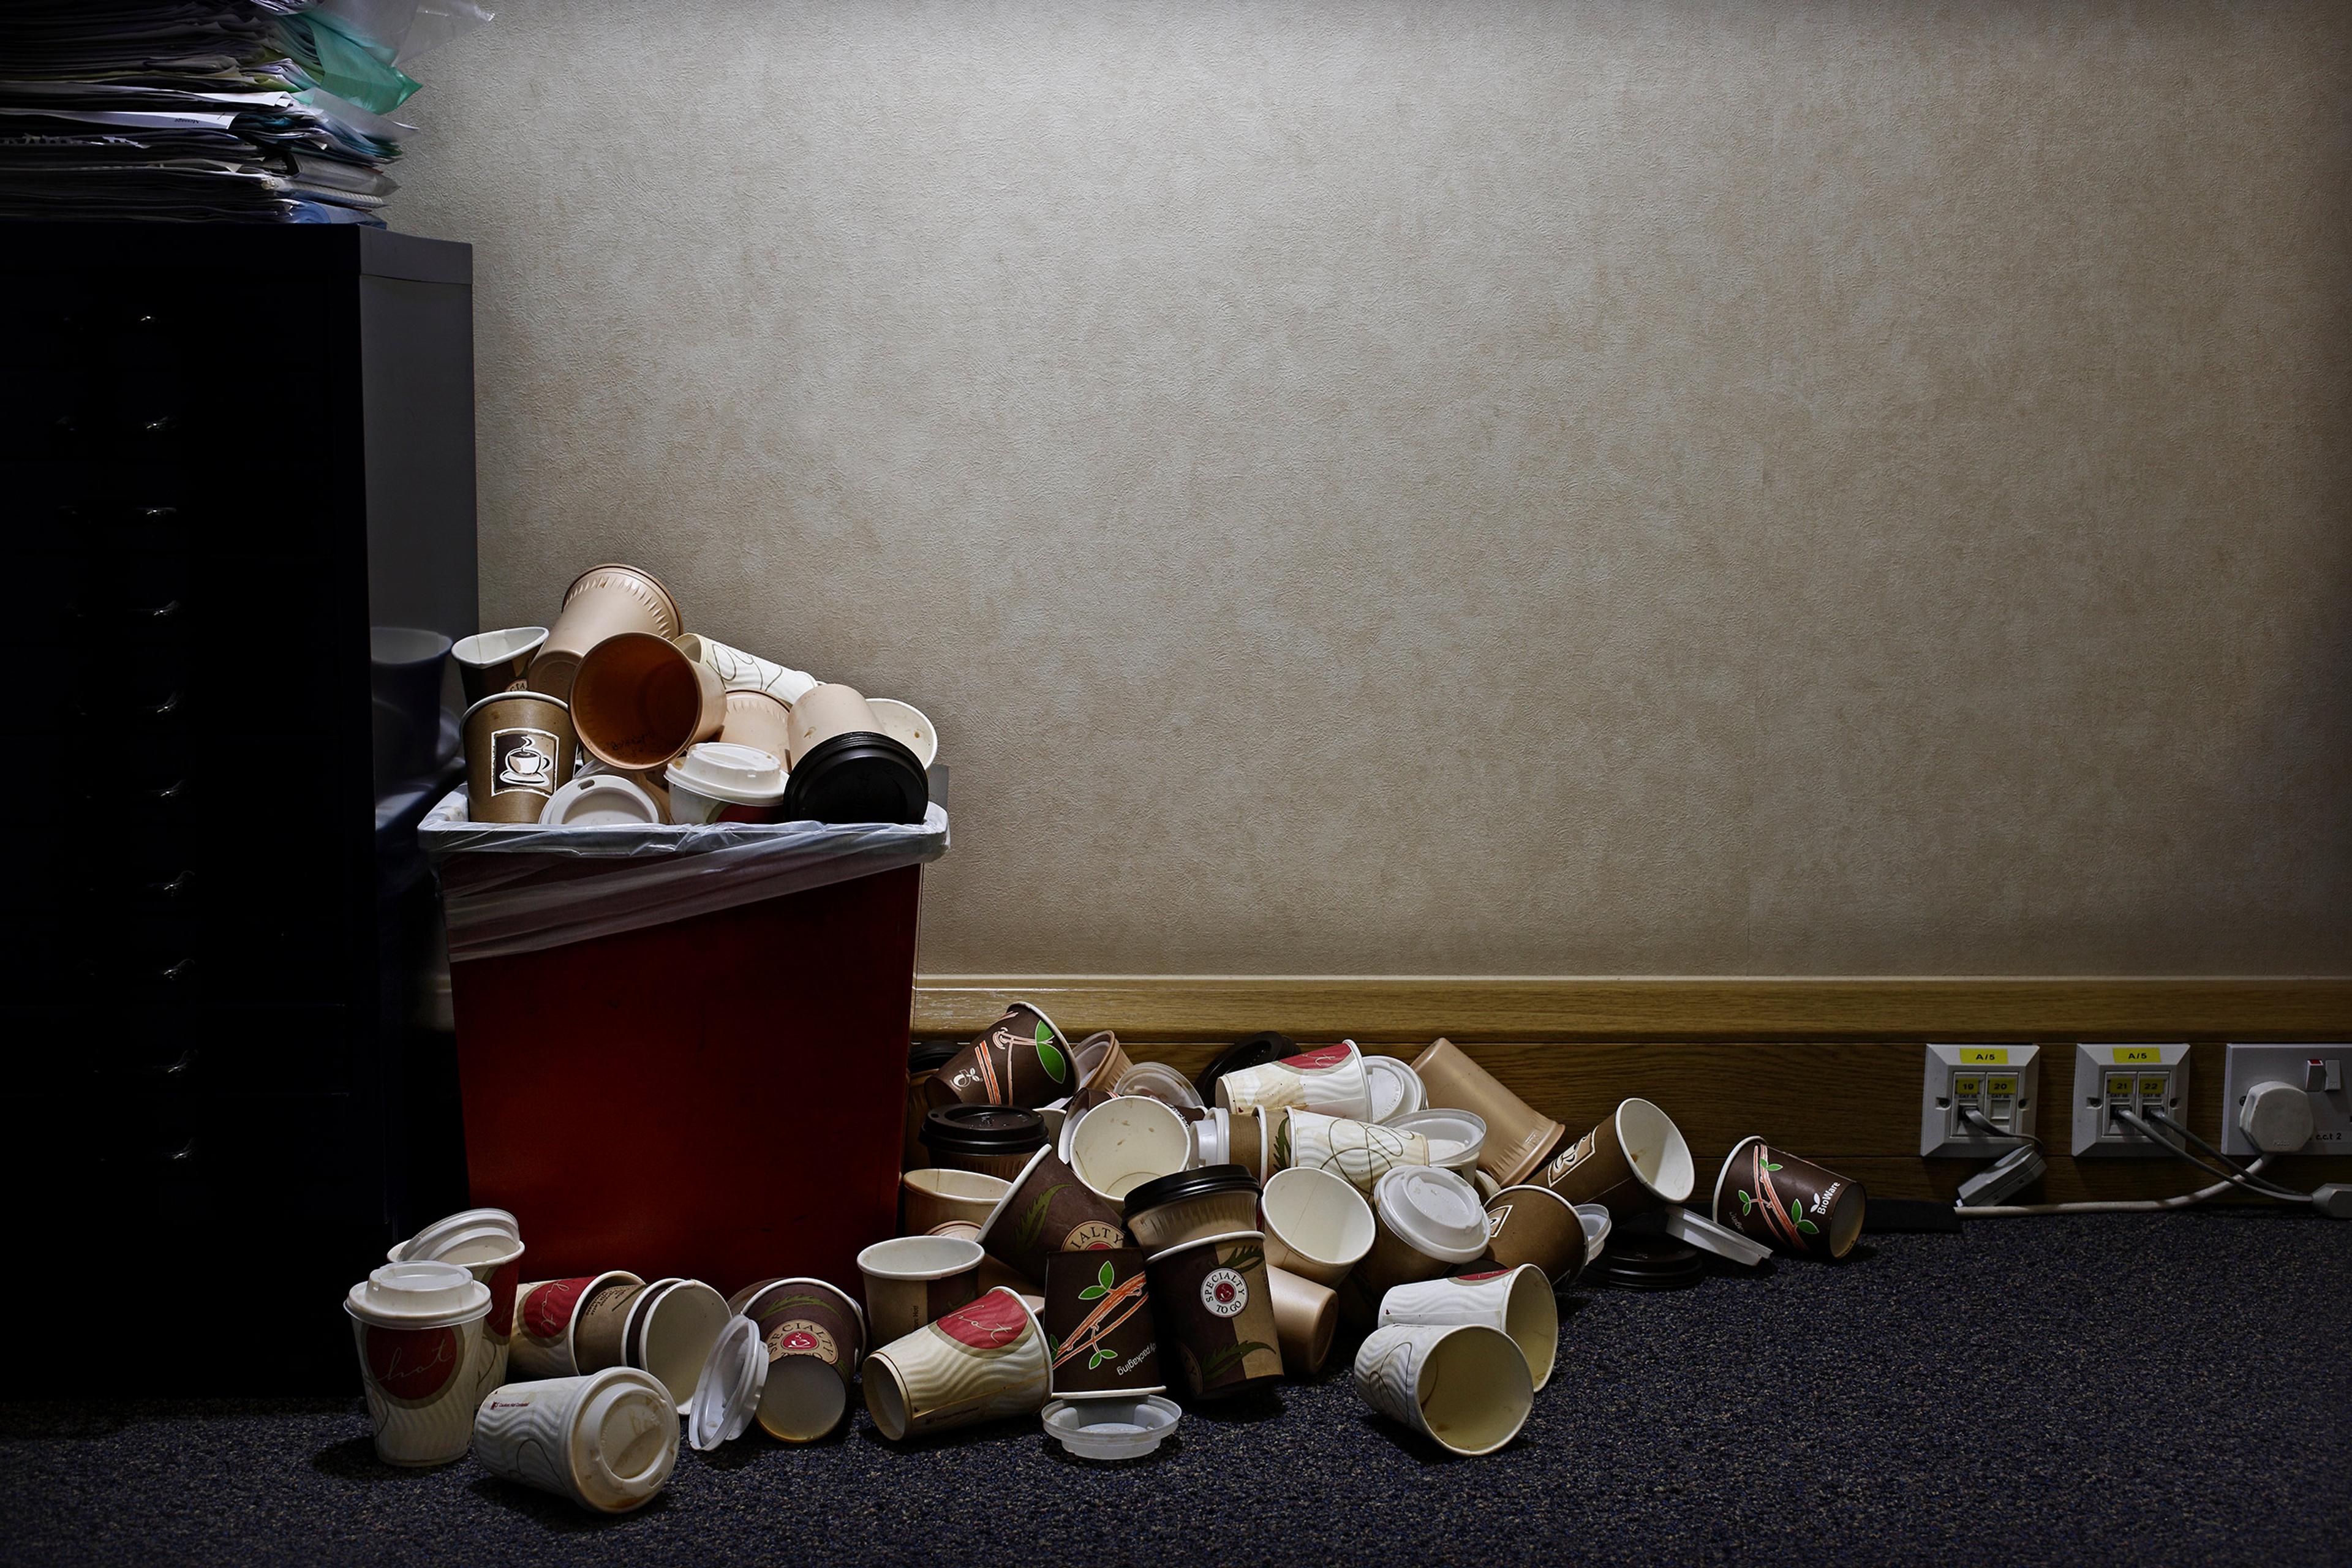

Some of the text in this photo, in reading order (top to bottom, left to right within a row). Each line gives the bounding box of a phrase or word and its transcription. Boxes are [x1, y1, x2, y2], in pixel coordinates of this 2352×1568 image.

[1071, 1227, 1125, 1250] IALTY
[1205, 1272, 1245, 1303] SPECIALTY
[1216, 1300, 1242, 1314] TO GO
[767, 1323, 834, 1356] SPECIALTY
[948, 1305, 1012, 1344] hot
[376, 1338, 453, 1381] hot
